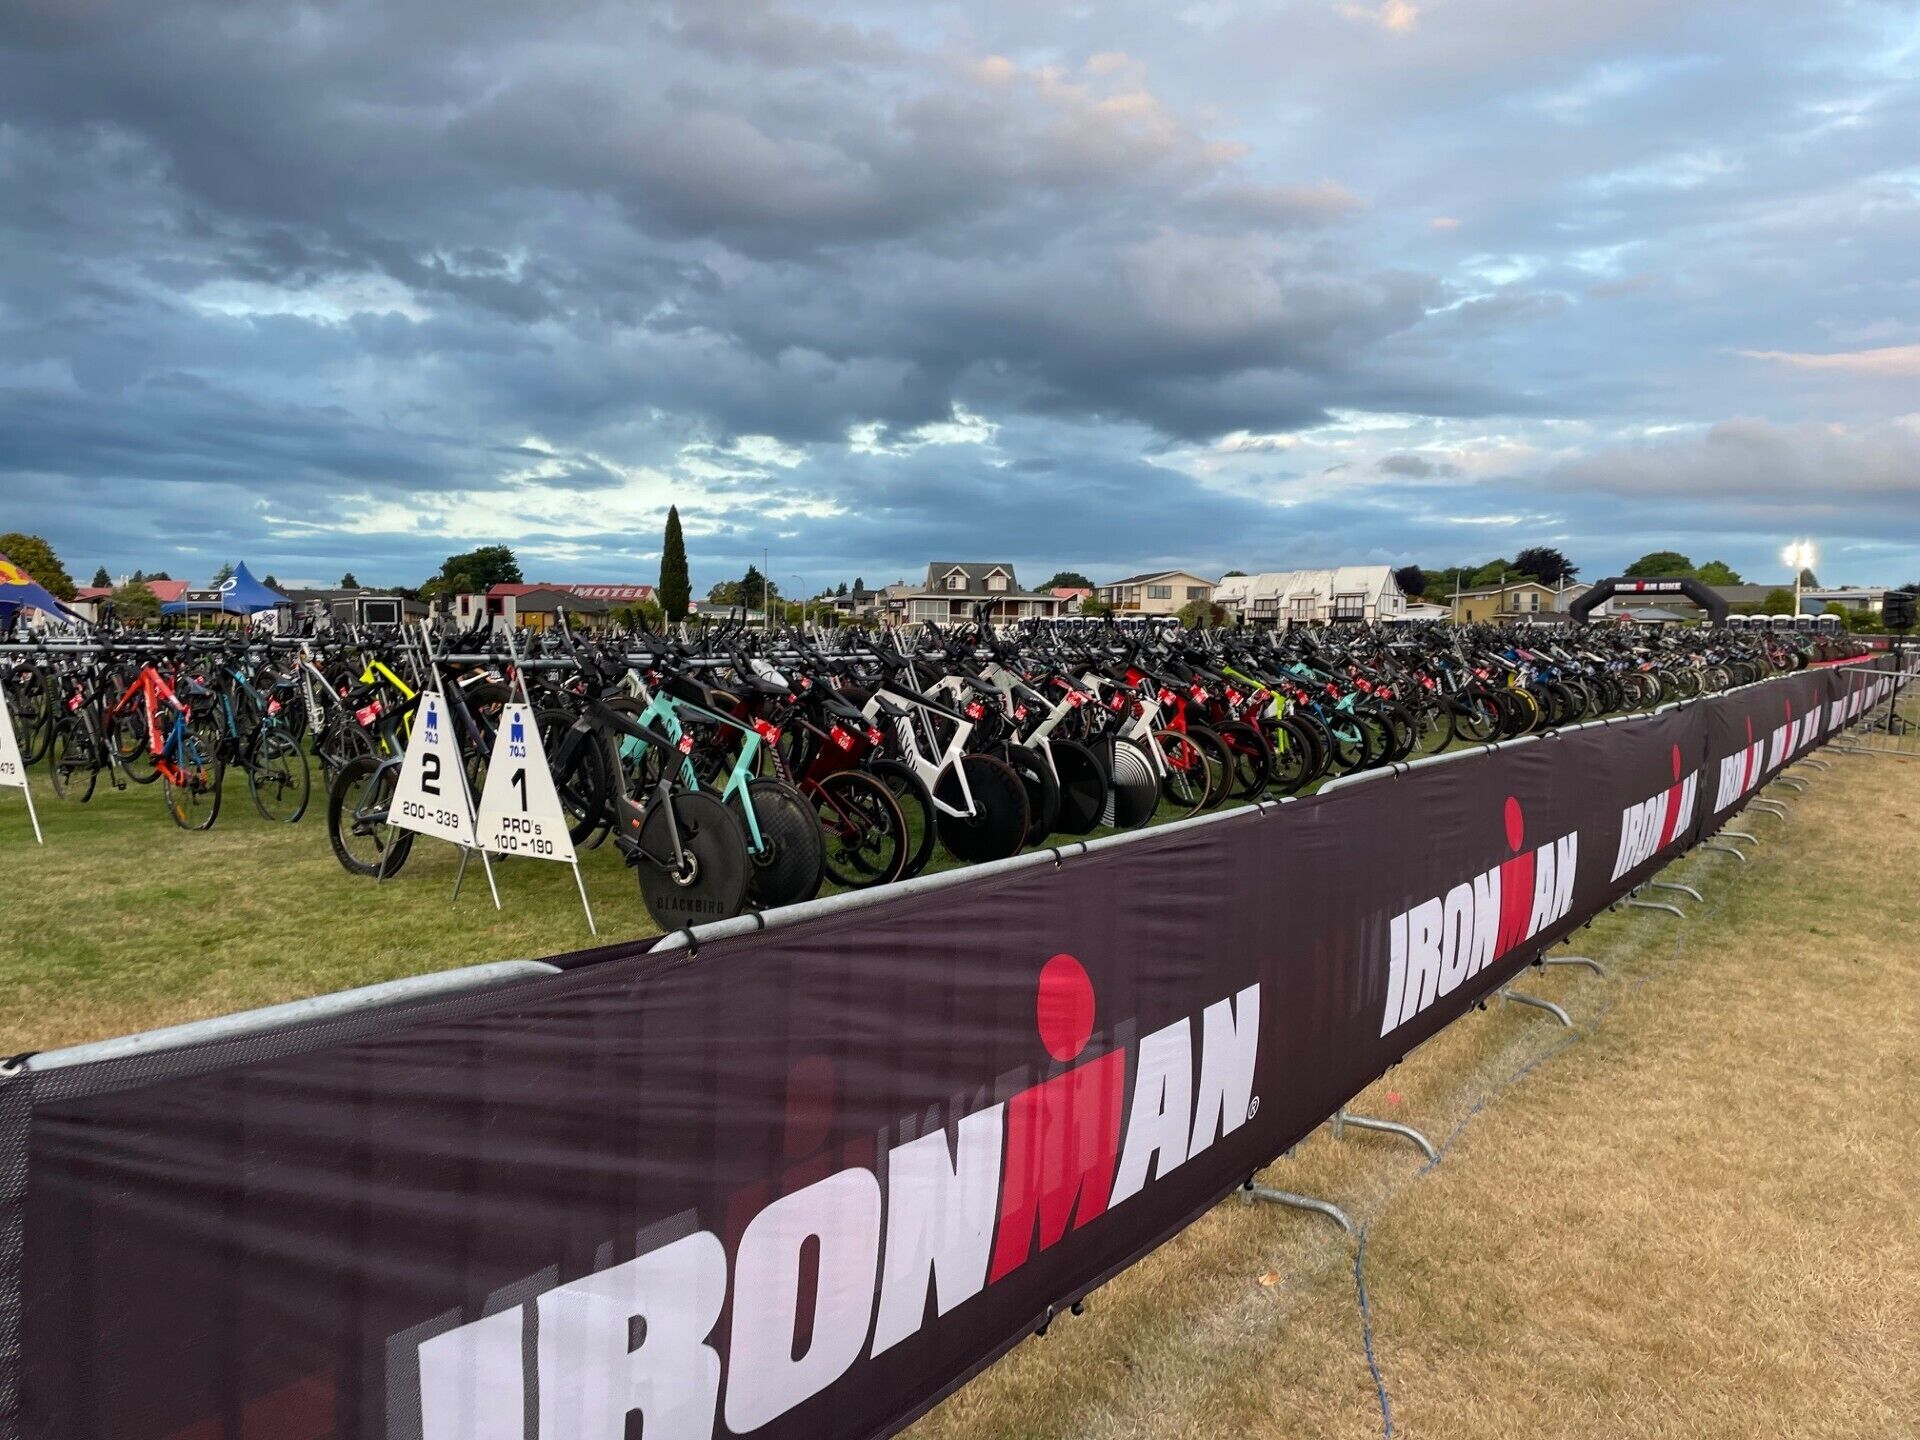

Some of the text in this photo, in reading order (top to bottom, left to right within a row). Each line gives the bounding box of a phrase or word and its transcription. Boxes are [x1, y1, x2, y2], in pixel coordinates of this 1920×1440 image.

[573, 587, 646, 598] MOTEL
[424, 731, 439, 745] 70.3
[509, 745, 526, 757] 70.3
[421, 752, 441, 796] 2
[511, 768, 528, 812] 1
[1610, 744, 1698, 883] IRONMAN
[502, 817, 542, 835] PRO's
[656, 896, 724, 914] BLACKBIRD
[1380, 796, 1577, 1038] IRONMAN
